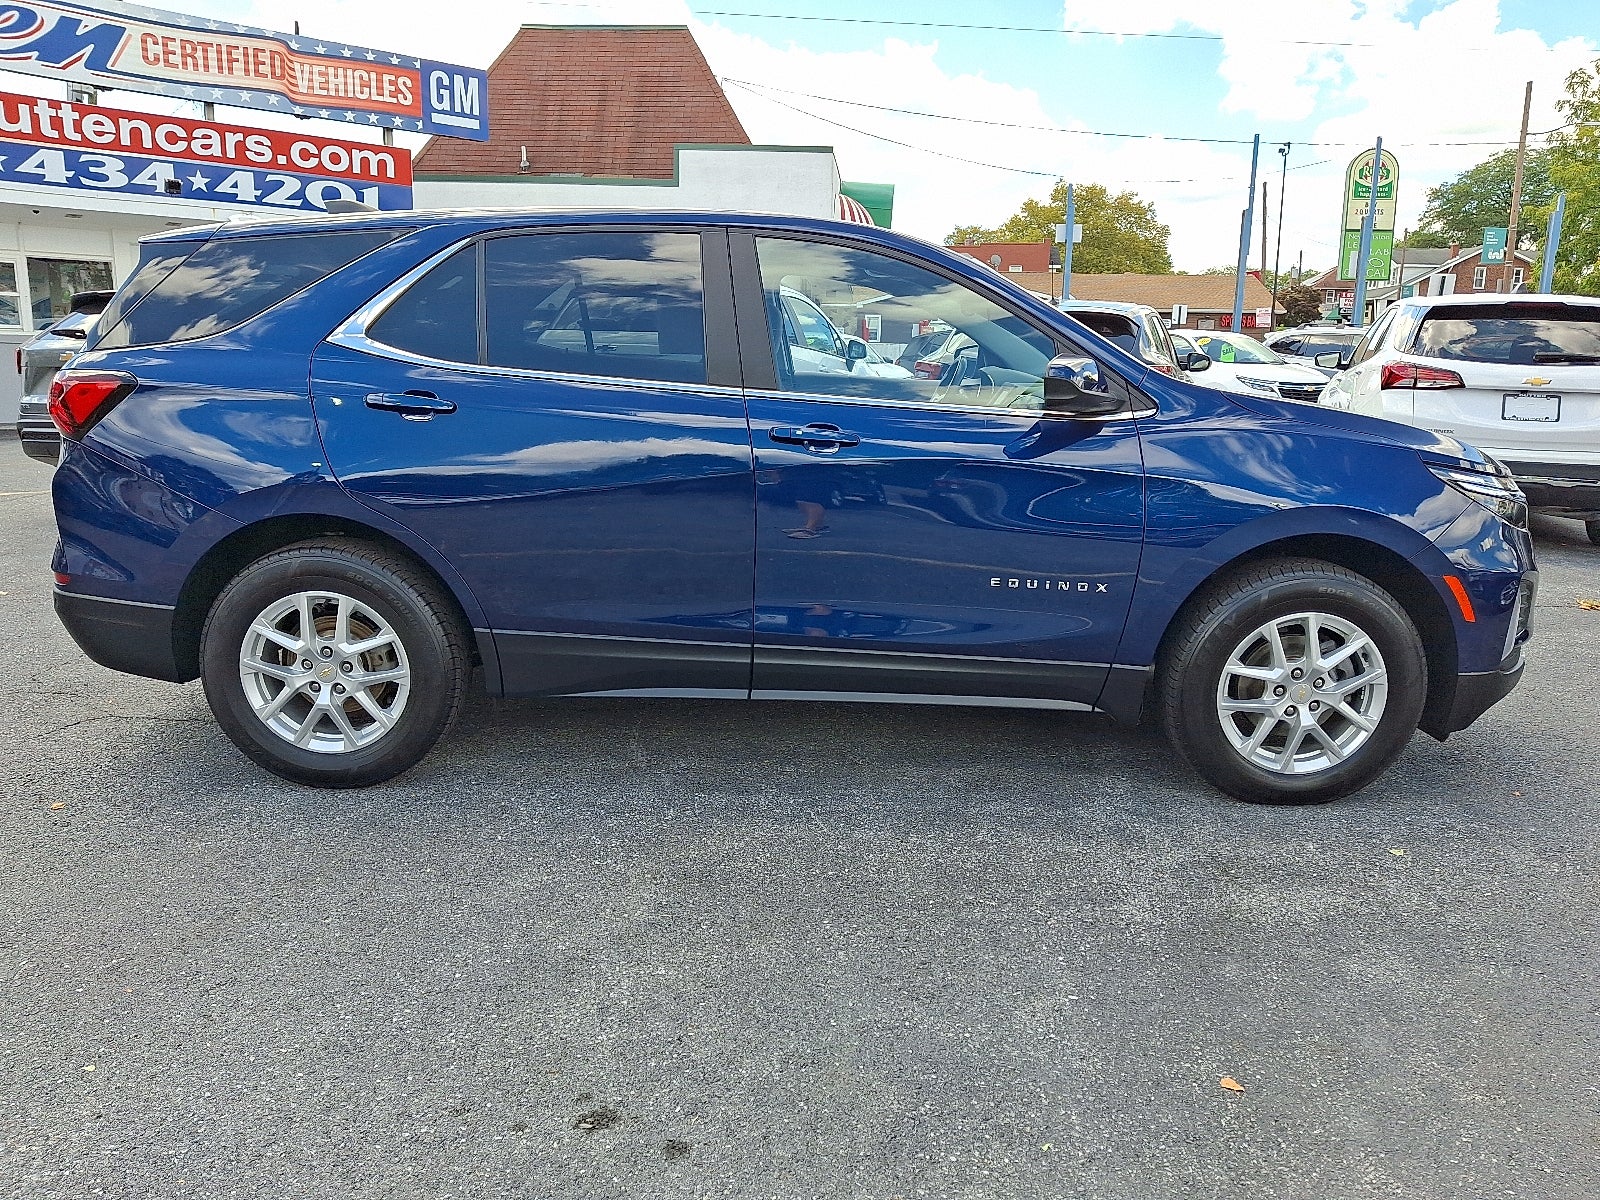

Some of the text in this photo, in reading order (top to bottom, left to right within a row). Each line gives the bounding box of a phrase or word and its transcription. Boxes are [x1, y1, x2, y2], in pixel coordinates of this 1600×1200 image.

[139, 32, 414, 106] CERTIFIED VEHICLES
[429, 69, 480, 116] GM
[0, 99, 396, 179] uttencars.com
[14, 148, 379, 211] 434 4201
[1369, 248, 1390, 256] LAB
[1222, 346, 1235, 356] SALE
